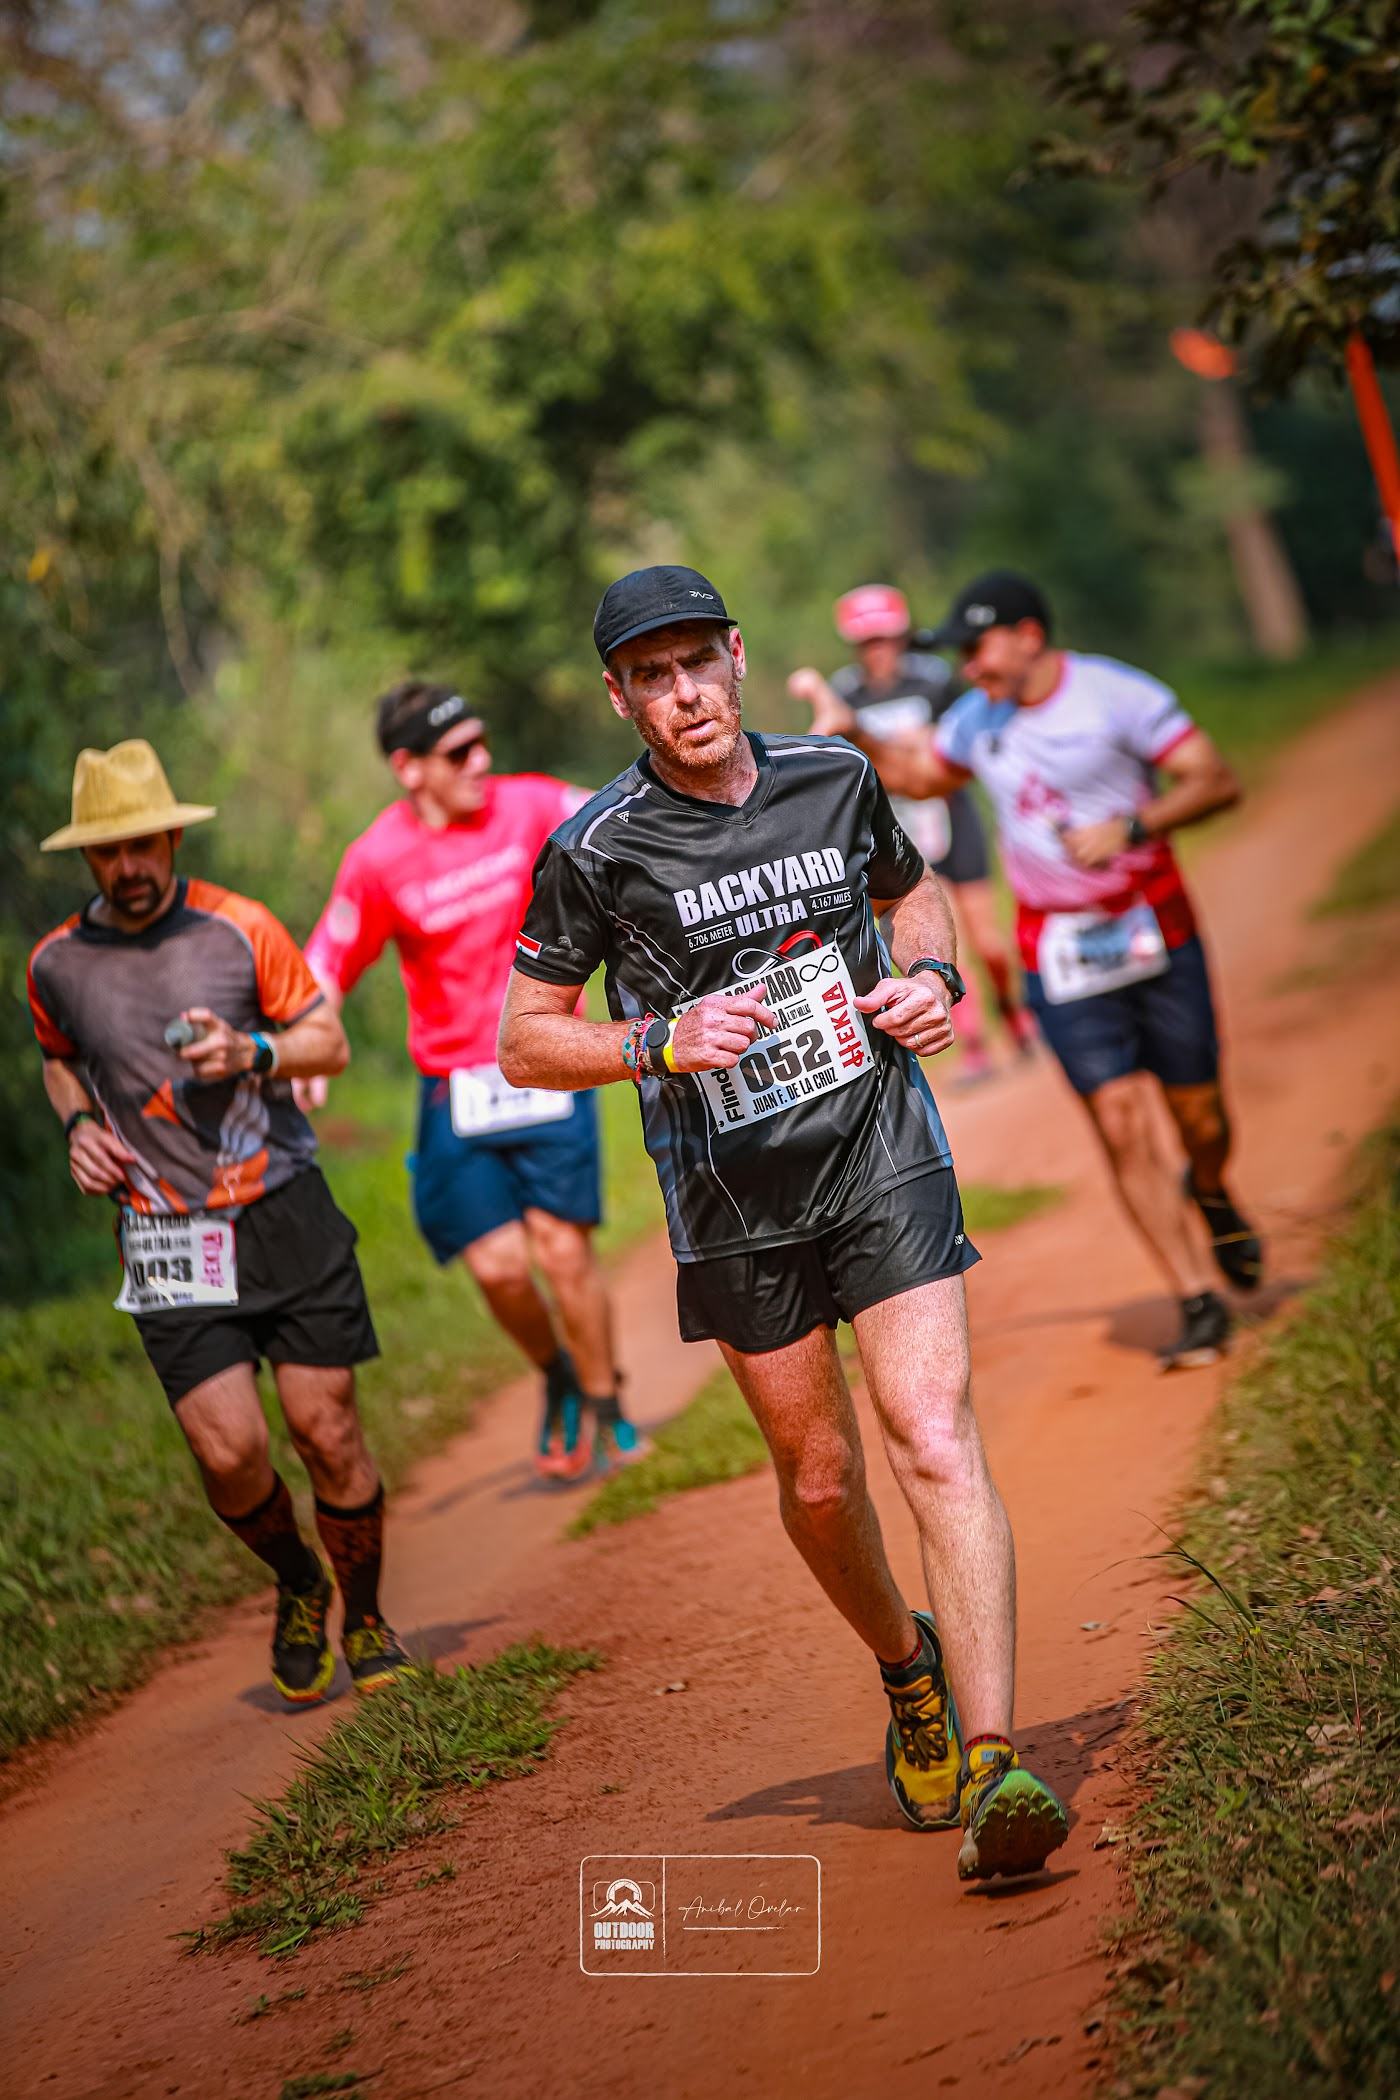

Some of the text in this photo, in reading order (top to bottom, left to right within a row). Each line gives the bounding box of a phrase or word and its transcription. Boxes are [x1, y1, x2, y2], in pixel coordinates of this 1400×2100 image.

[673, 847, 846, 928] BACKYARD
[811, 891, 852, 910] 4.167 MILES
[688, 925, 735, 949] 6.706 METER
[735, 899, 808, 937] ULTRA
[739, 1029, 832, 1093] 052
[753, 1067, 839, 1115] JUAN F. DE LA CRUZ
